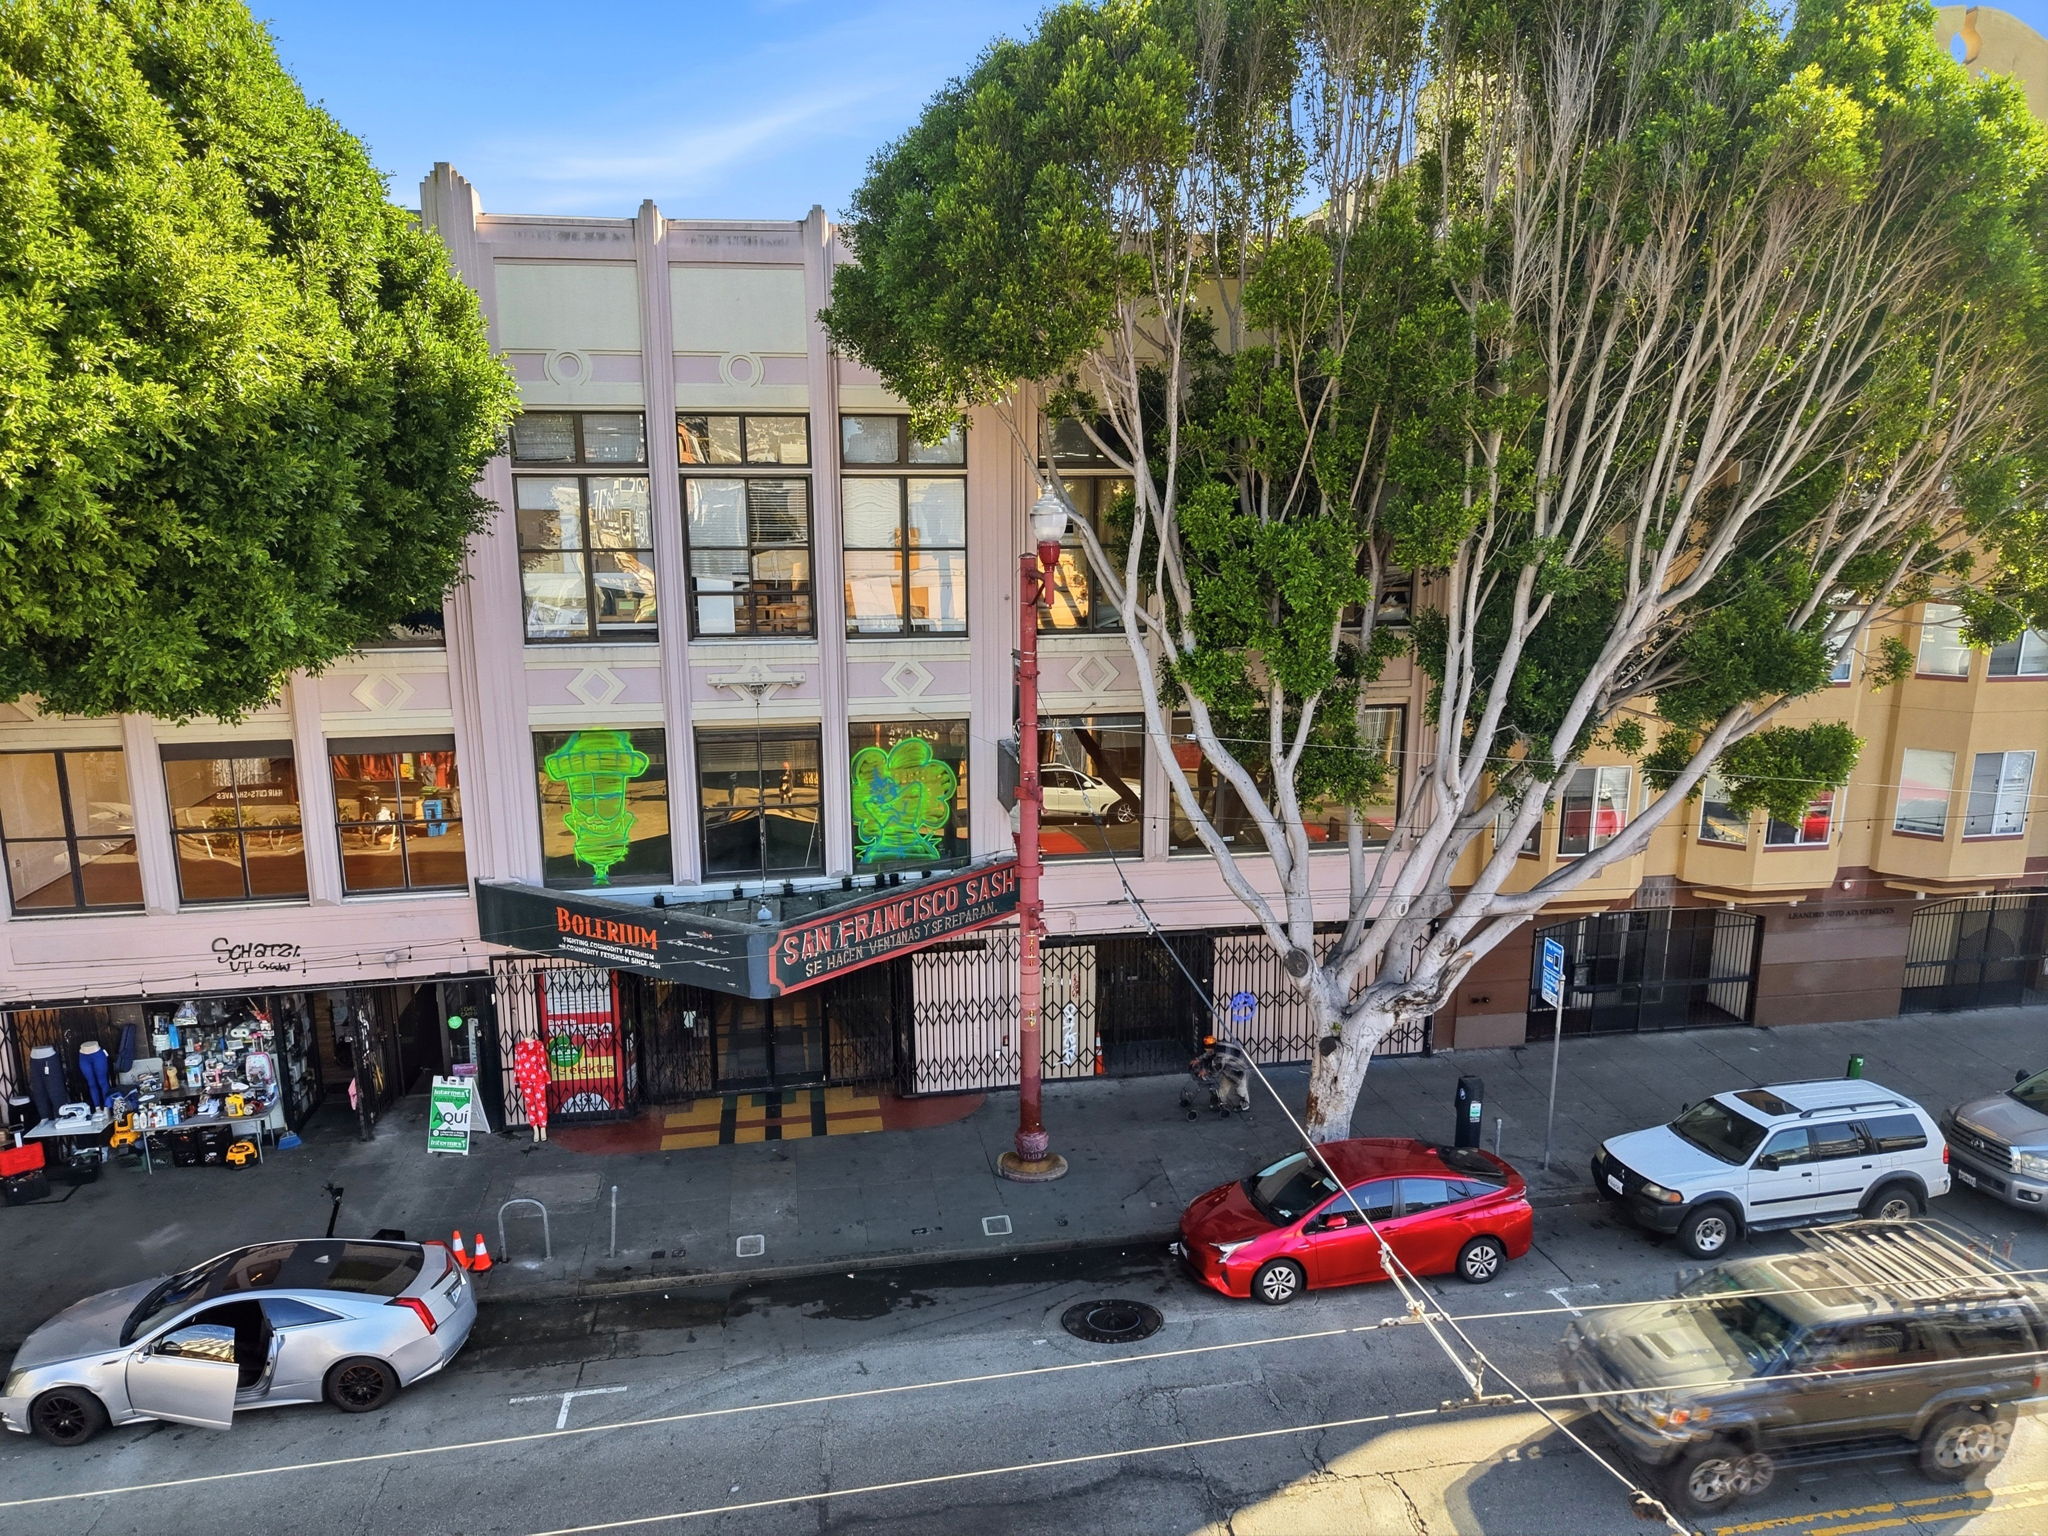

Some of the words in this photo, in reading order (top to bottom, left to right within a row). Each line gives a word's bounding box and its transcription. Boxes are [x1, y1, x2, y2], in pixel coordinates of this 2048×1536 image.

[556, 906, 658, 951] BOLERIUM
[783, 927, 832, 966] SAN
[839, 886, 959, 949] FRANCISCO
[966, 868, 1016, 905] SASH
[562, 936, 589, 948] FIGHTING
[590, 941, 623, 955] COMMODITY
[624, 949, 655, 961] FETISHISM
[566, 944, 599, 958] COMMODITY
[600, 951, 630, 963] FETISHISM
[630, 957, 648, 967] SINCE
[805, 958, 822, 979] SE
[826, 947, 864, 971] HACEN
[869, 926, 921, 955] VENTANAS
[923, 923, 931, 937] Y
[931, 920, 943, 934] SE
[569, 1063, 614, 1075] elektra
[433, 1110, 470, 1126] AQUÍ
